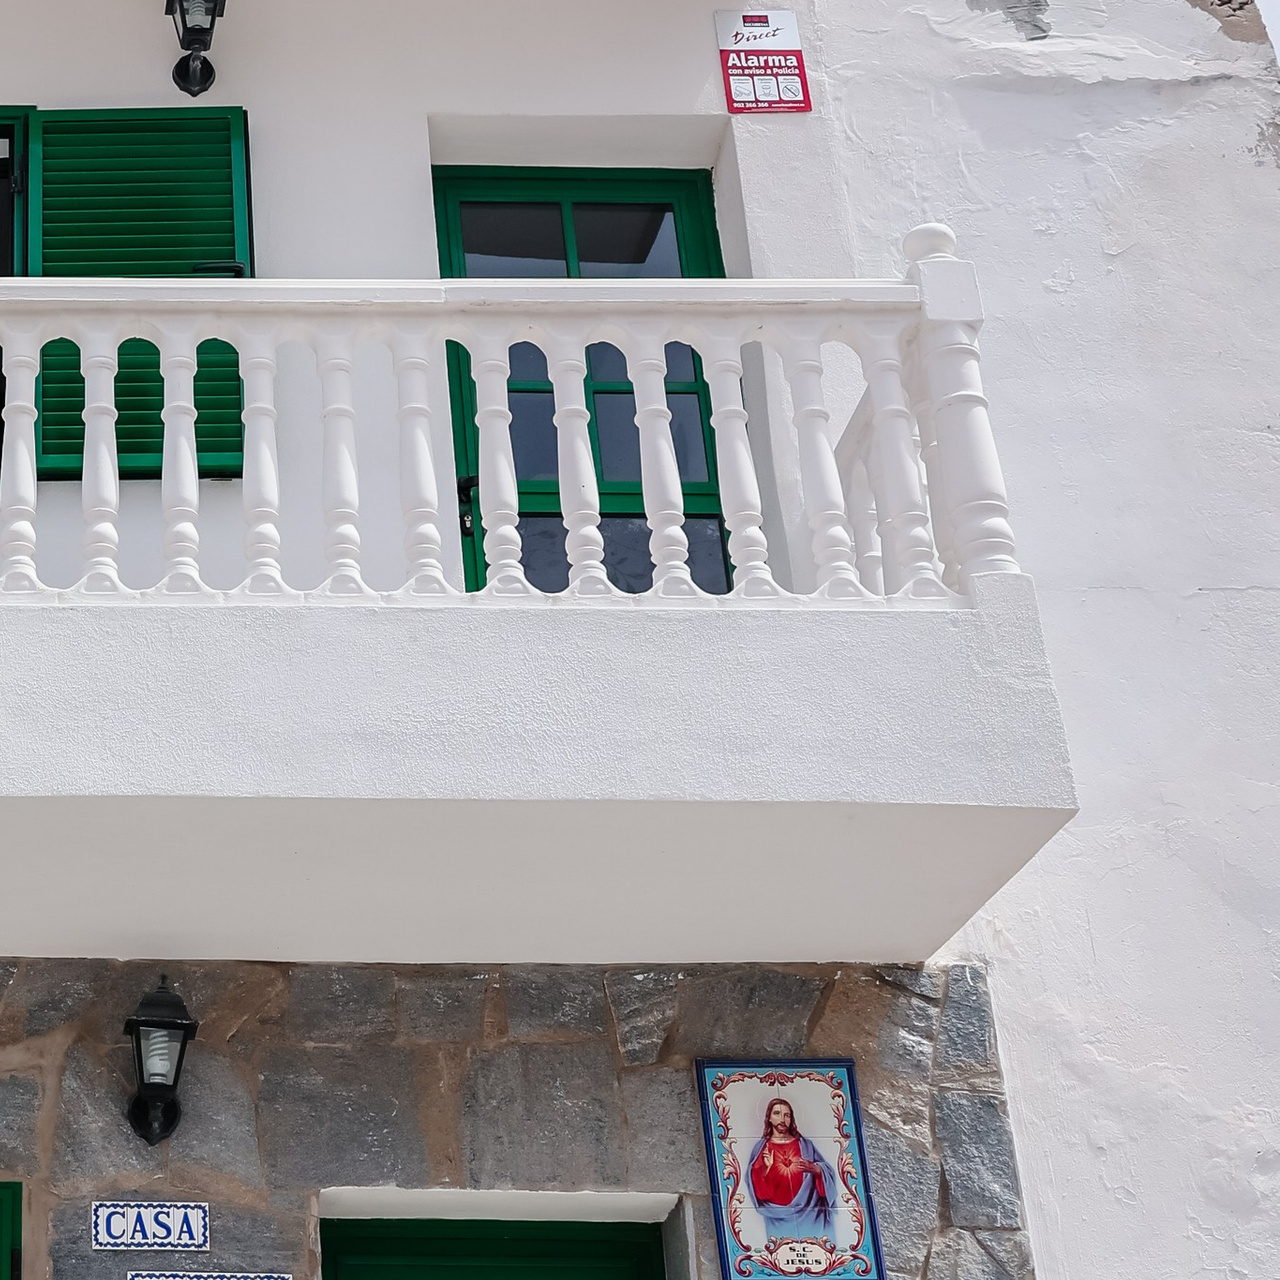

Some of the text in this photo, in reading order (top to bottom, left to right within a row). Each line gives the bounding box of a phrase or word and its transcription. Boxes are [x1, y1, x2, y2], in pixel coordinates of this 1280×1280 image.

[731, 27, 786, 45] Direct
[727, 52, 798, 67] Alarma
[105, 1210, 196, 1241] CASA
